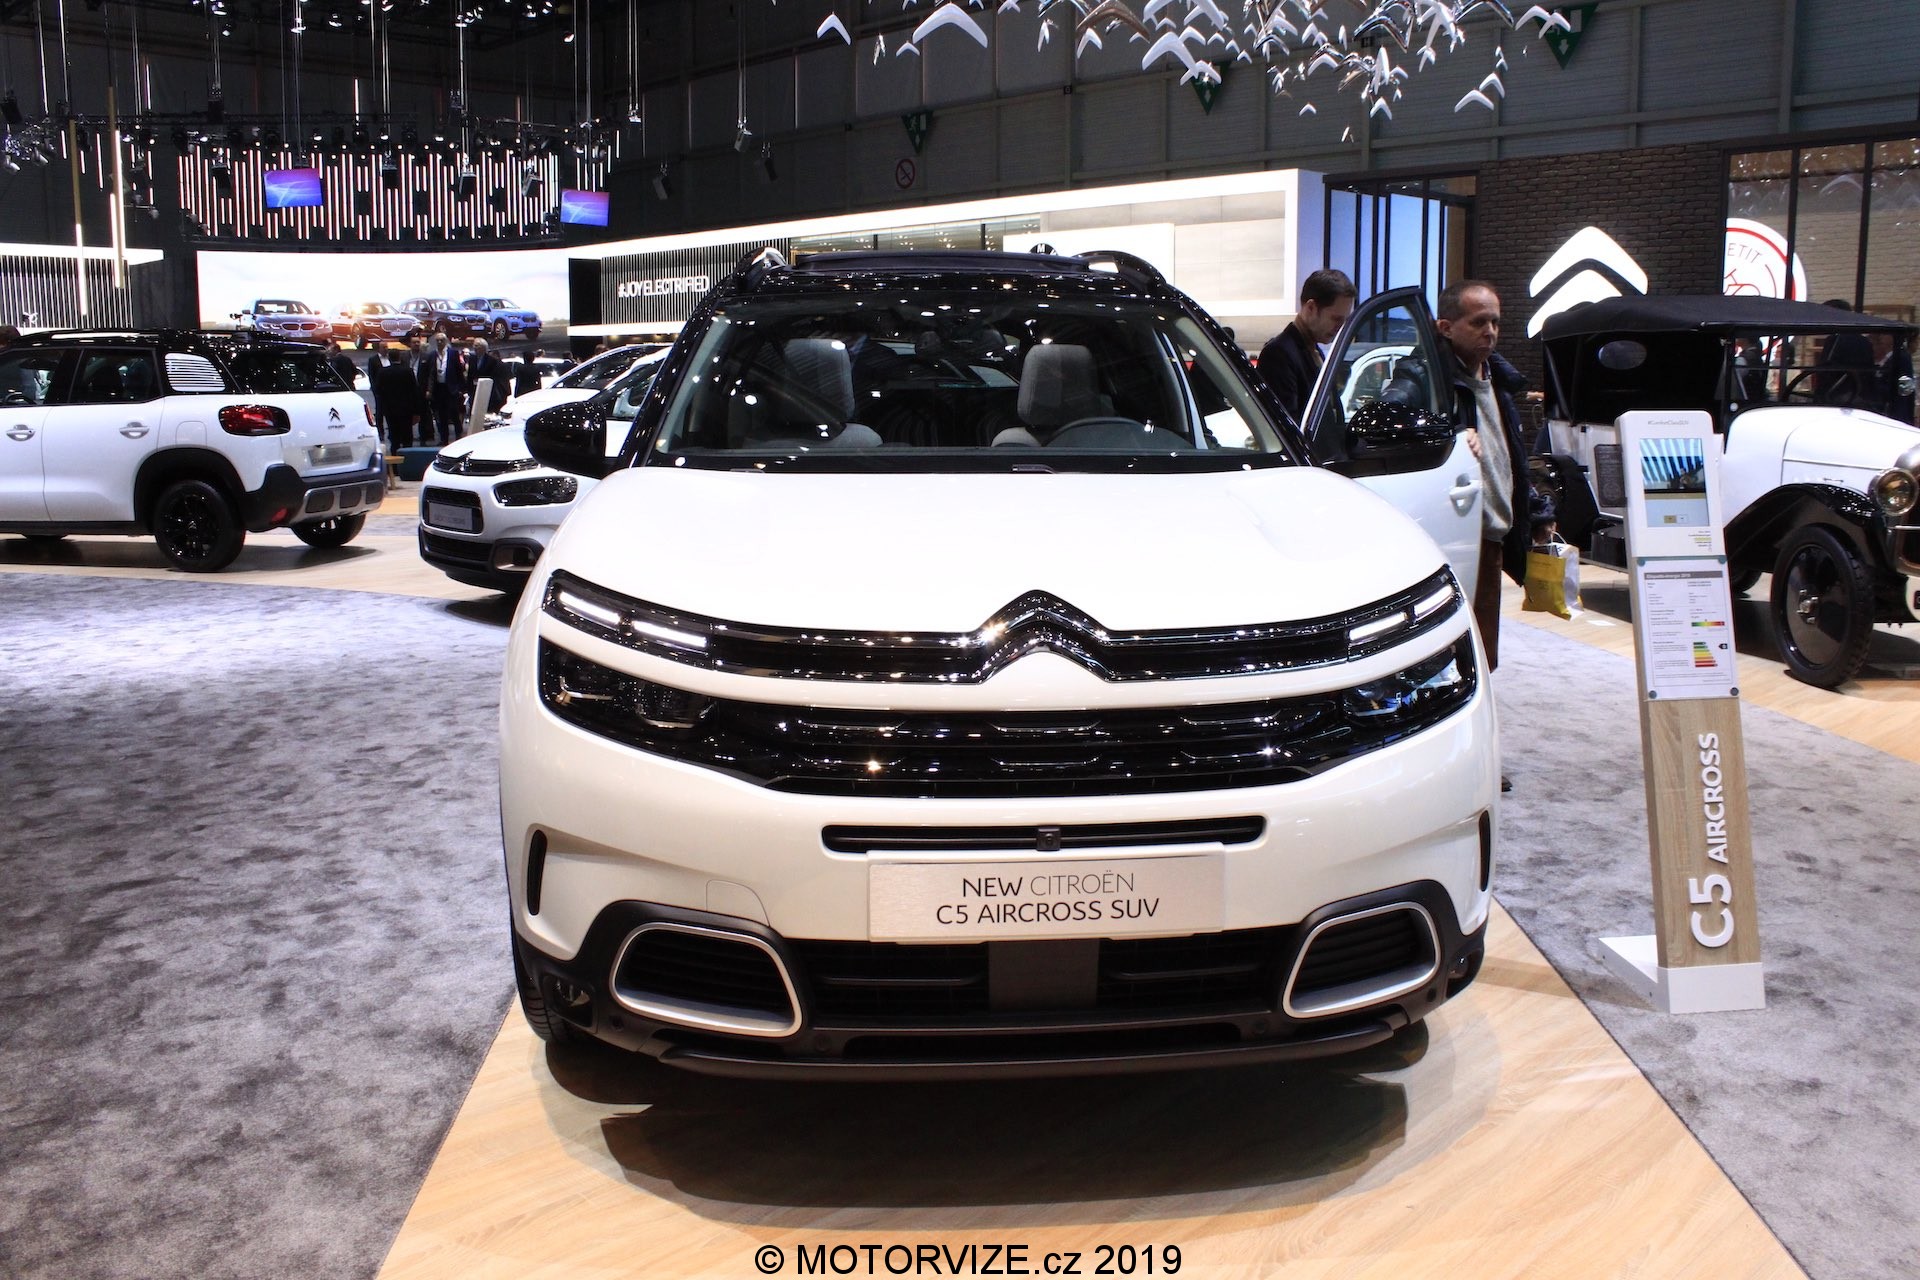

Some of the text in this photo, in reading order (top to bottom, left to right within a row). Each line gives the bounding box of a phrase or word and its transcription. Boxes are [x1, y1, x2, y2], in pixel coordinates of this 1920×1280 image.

[1726, 242, 1762, 264] ETIT
[1688, 732, 1735, 948] C5 AIRCROSS
[962, 869, 1135, 898] NEW CITROËN
[936, 897, 1160, 925] C5 AIRCROSS SUV
